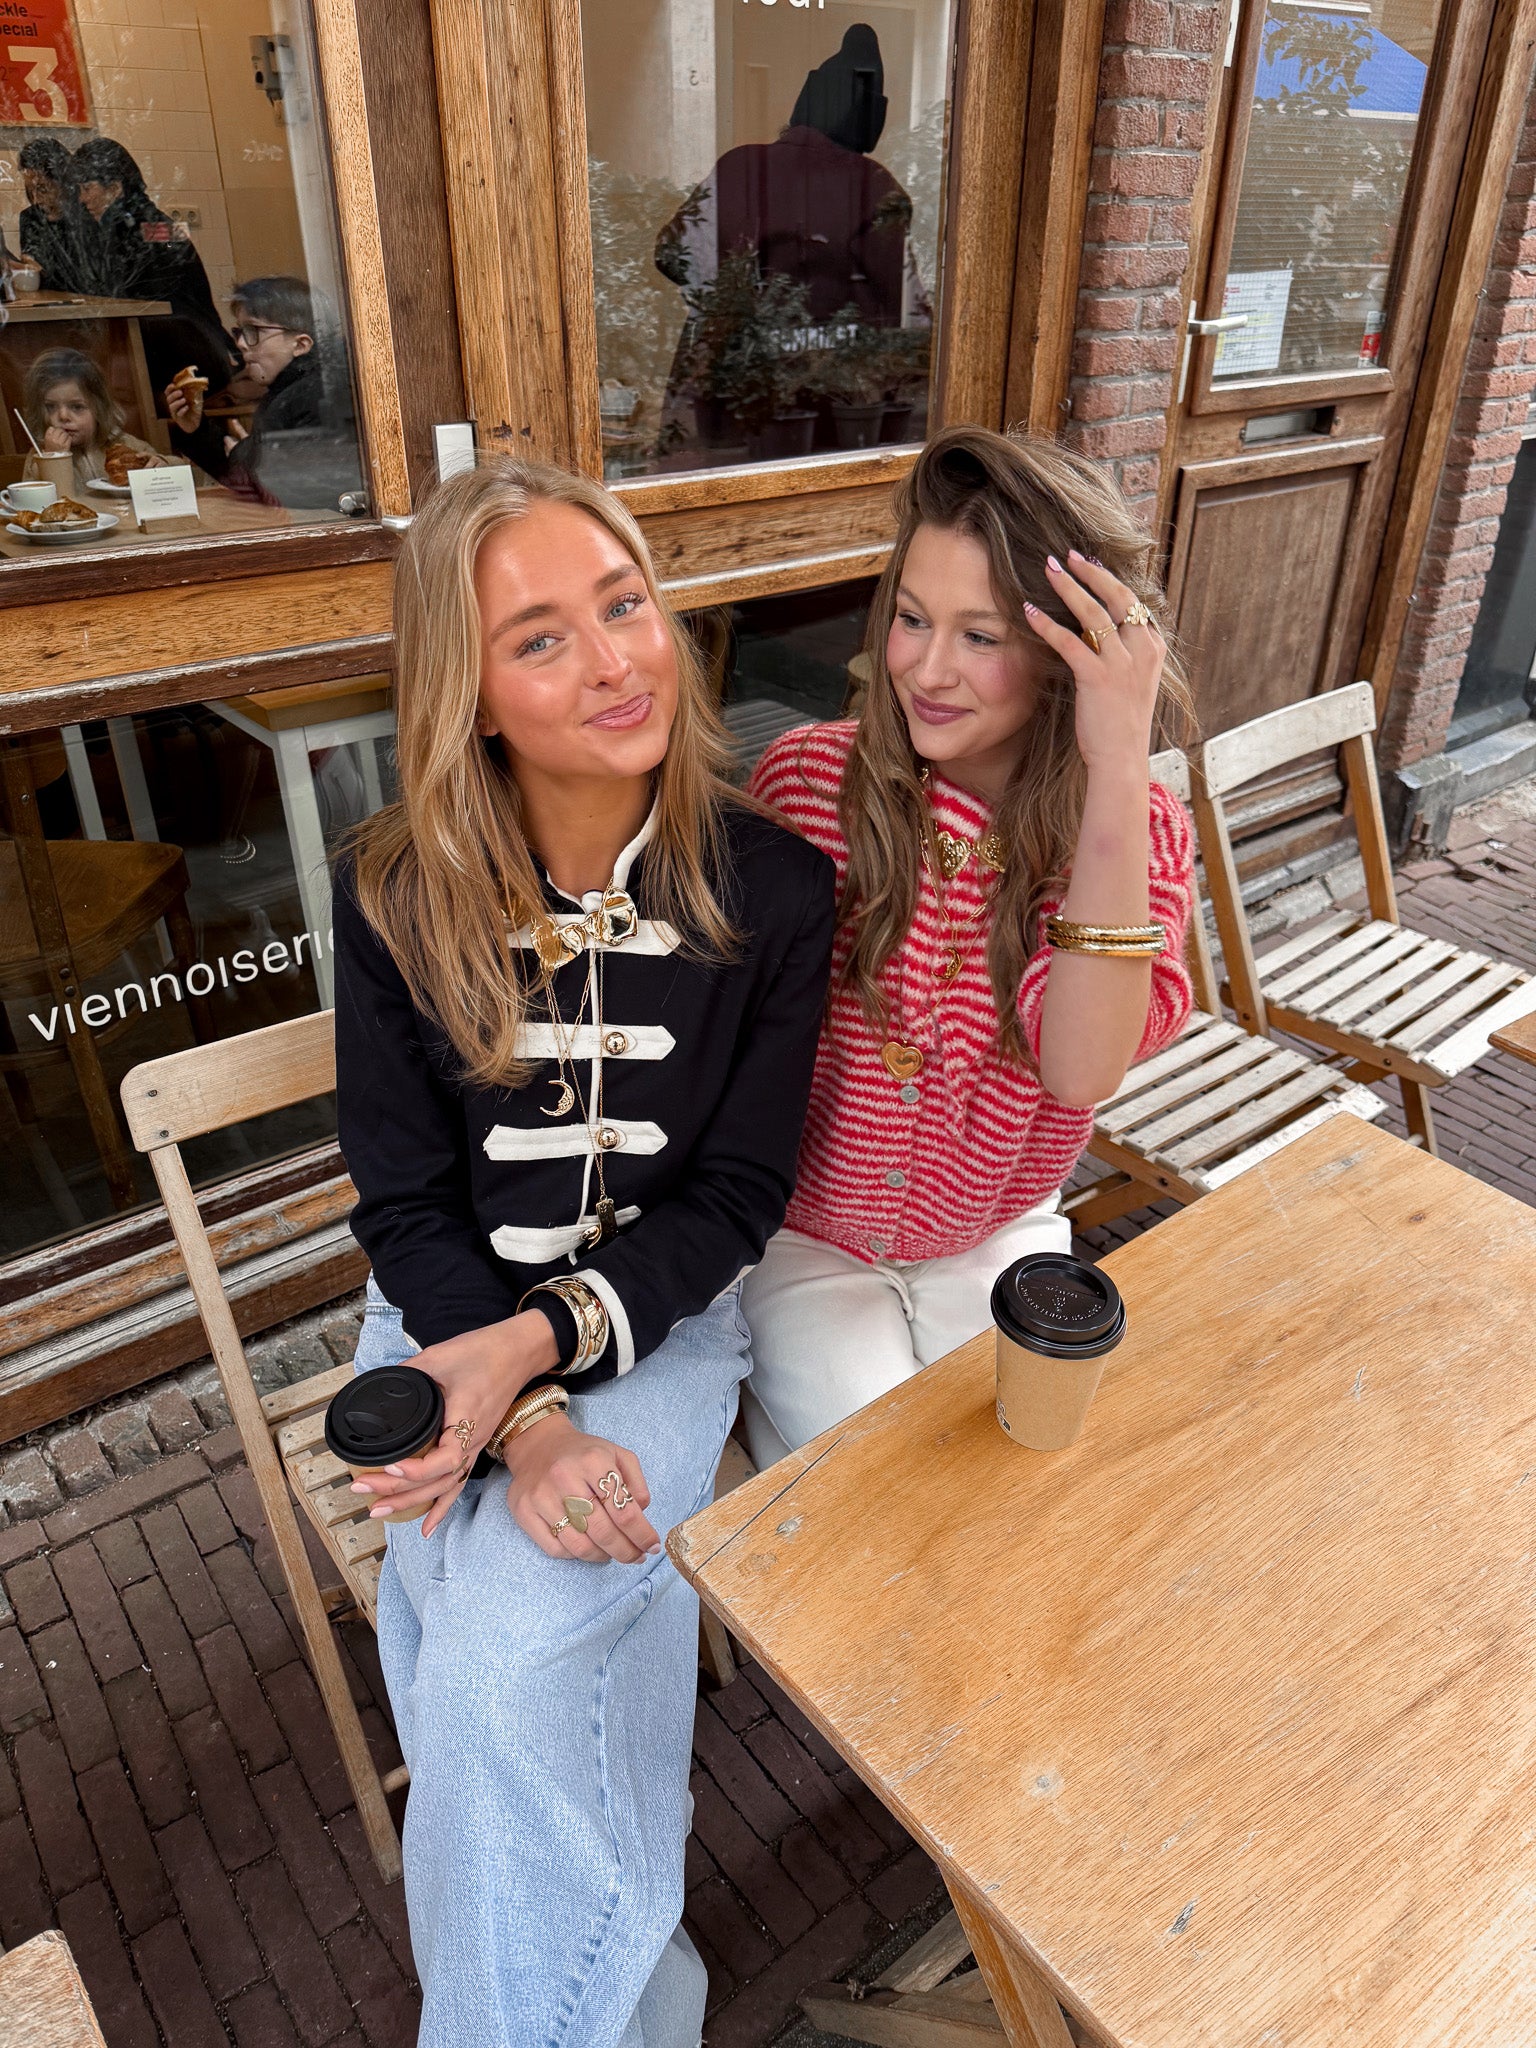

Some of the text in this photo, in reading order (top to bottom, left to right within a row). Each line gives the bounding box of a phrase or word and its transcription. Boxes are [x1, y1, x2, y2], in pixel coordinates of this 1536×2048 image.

[0, 22, 38, 37] ecial
[8, 45, 68, 121] 3
[28, 928, 334, 1041] viennoiseri
